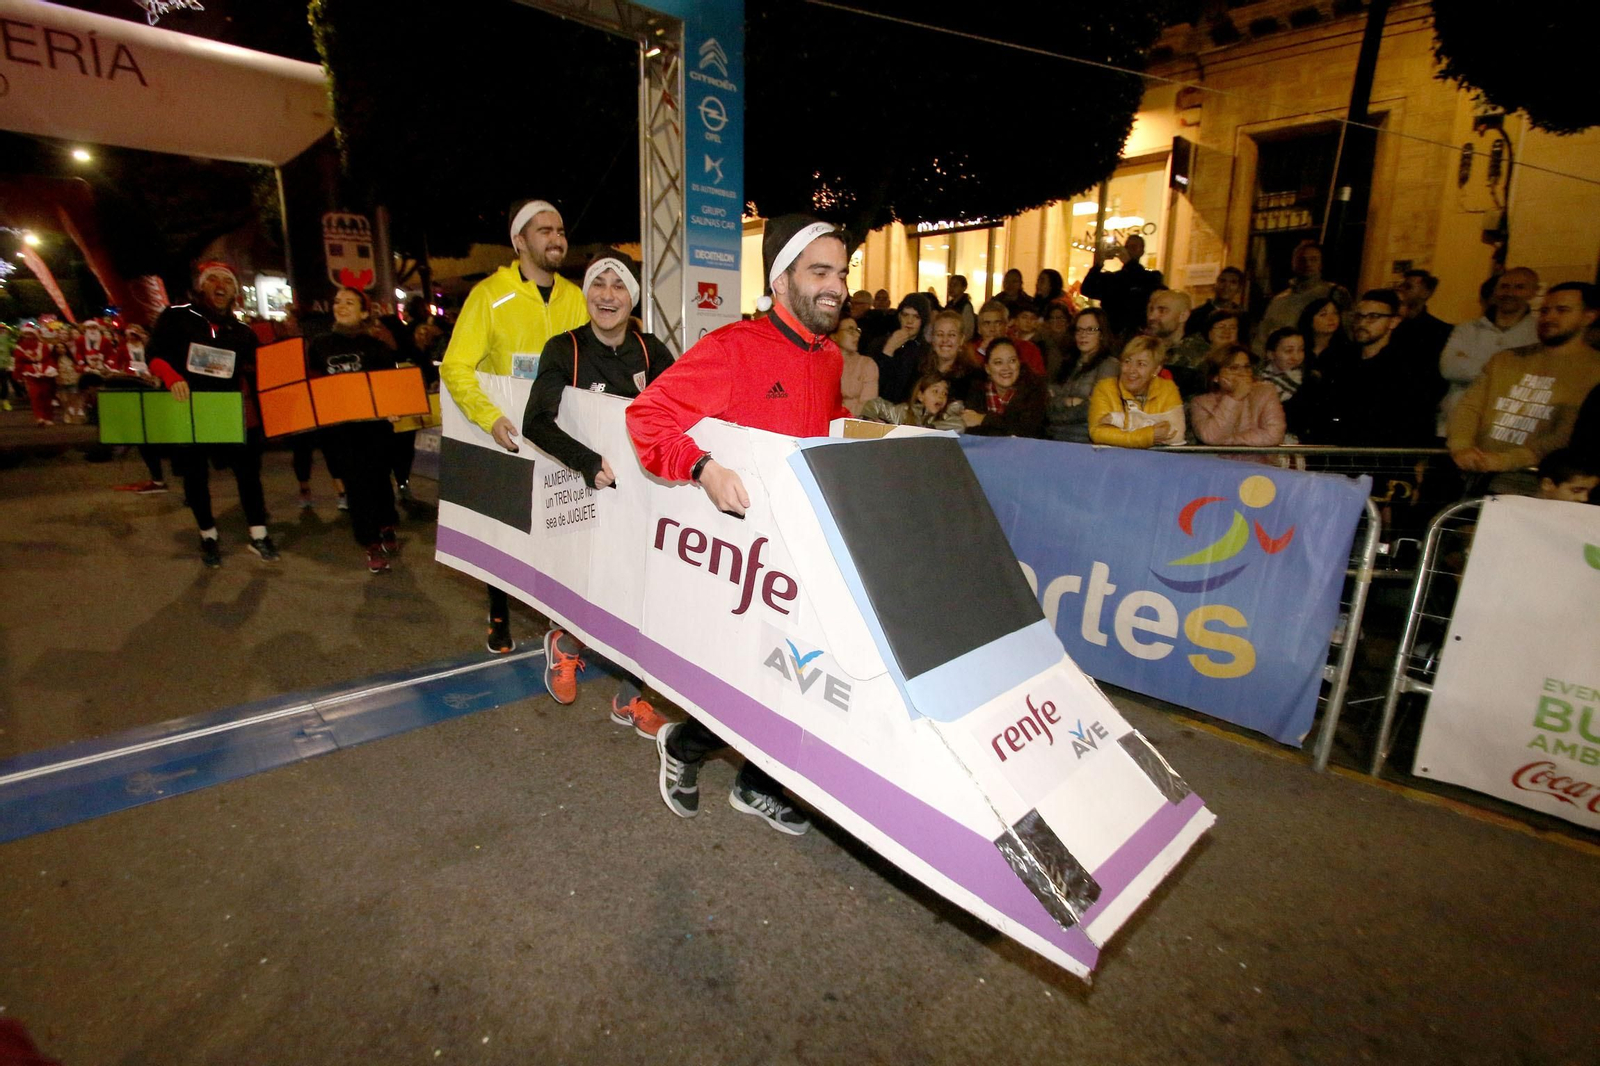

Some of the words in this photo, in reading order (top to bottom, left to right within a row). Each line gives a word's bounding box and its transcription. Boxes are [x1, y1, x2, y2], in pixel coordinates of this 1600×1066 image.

[690, 215, 721, 228] SALINAS
[721, 220, 736, 230] CAR
[701, 205, 727, 218] GRUPO
[694, 249, 735, 263] DECATHLON
[545, 497, 554, 508] un
[554, 488, 573, 506] TREN
[573, 488, 584, 504] que
[546, 516, 557, 529] sea
[558, 512, 566, 527] de
[566, 503, 596, 525] JUGUETE
[654, 516, 798, 615] renfe
[763, 645, 852, 712] AVE
[991, 694, 1062, 763] renfe
[1070, 720, 1110, 760] AVE
